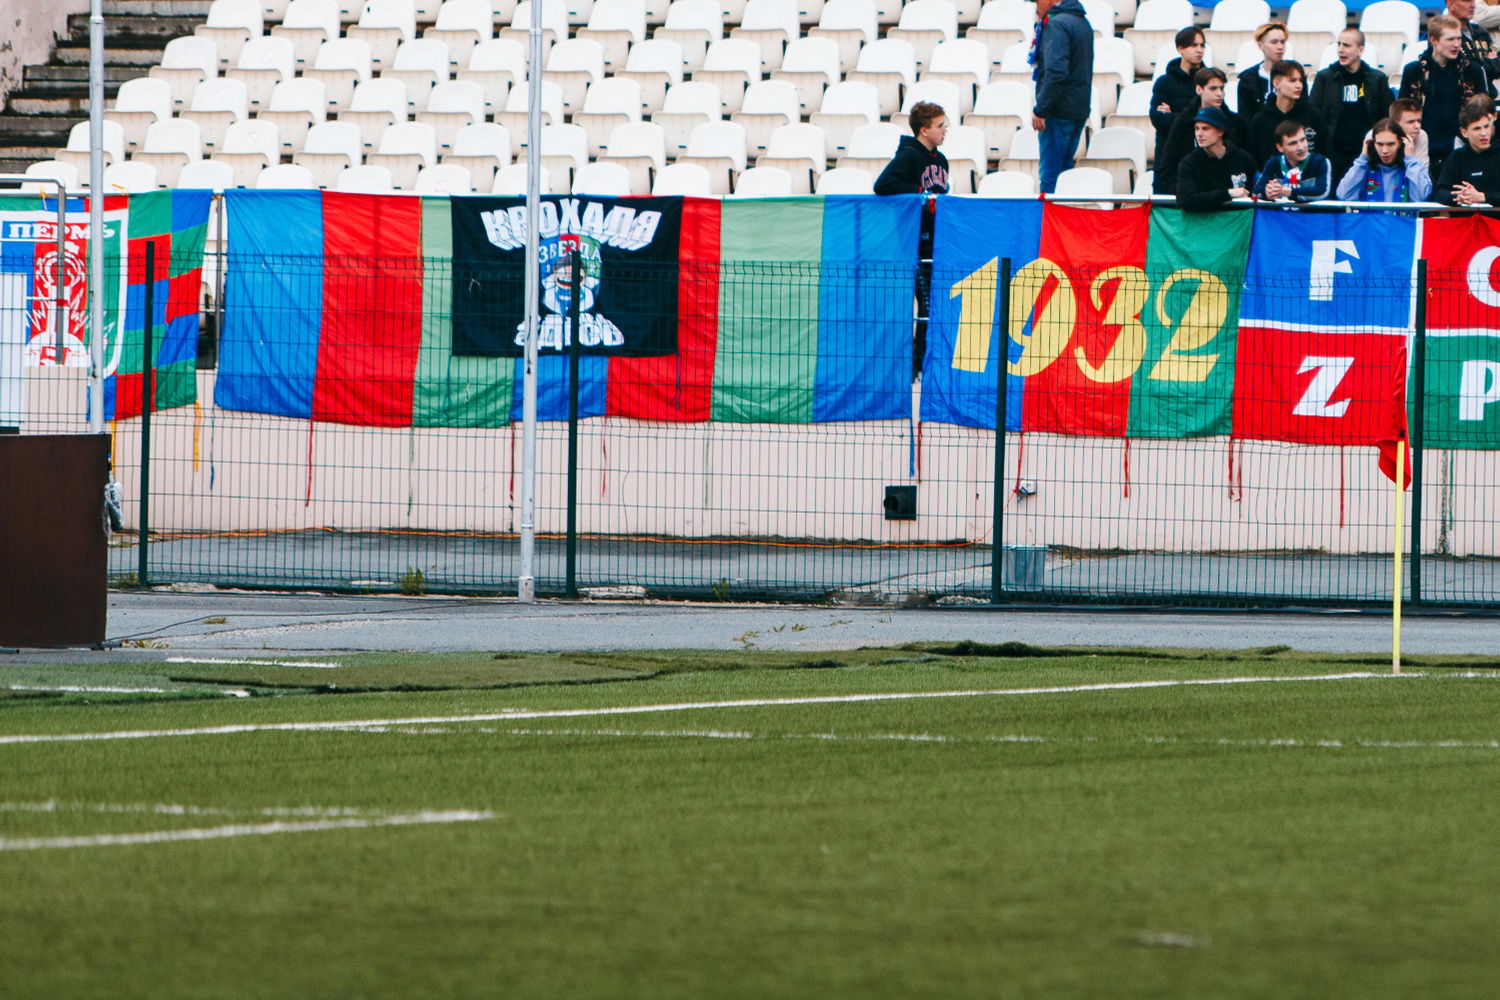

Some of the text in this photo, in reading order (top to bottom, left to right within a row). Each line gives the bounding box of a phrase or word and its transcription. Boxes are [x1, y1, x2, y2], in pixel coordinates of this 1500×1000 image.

[480, 198, 663, 251] КРОХАЛЯ
[1308, 239, 1361, 302] F
[949, 255, 1230, 383] 1932
[1292, 355, 1355, 418] Z
